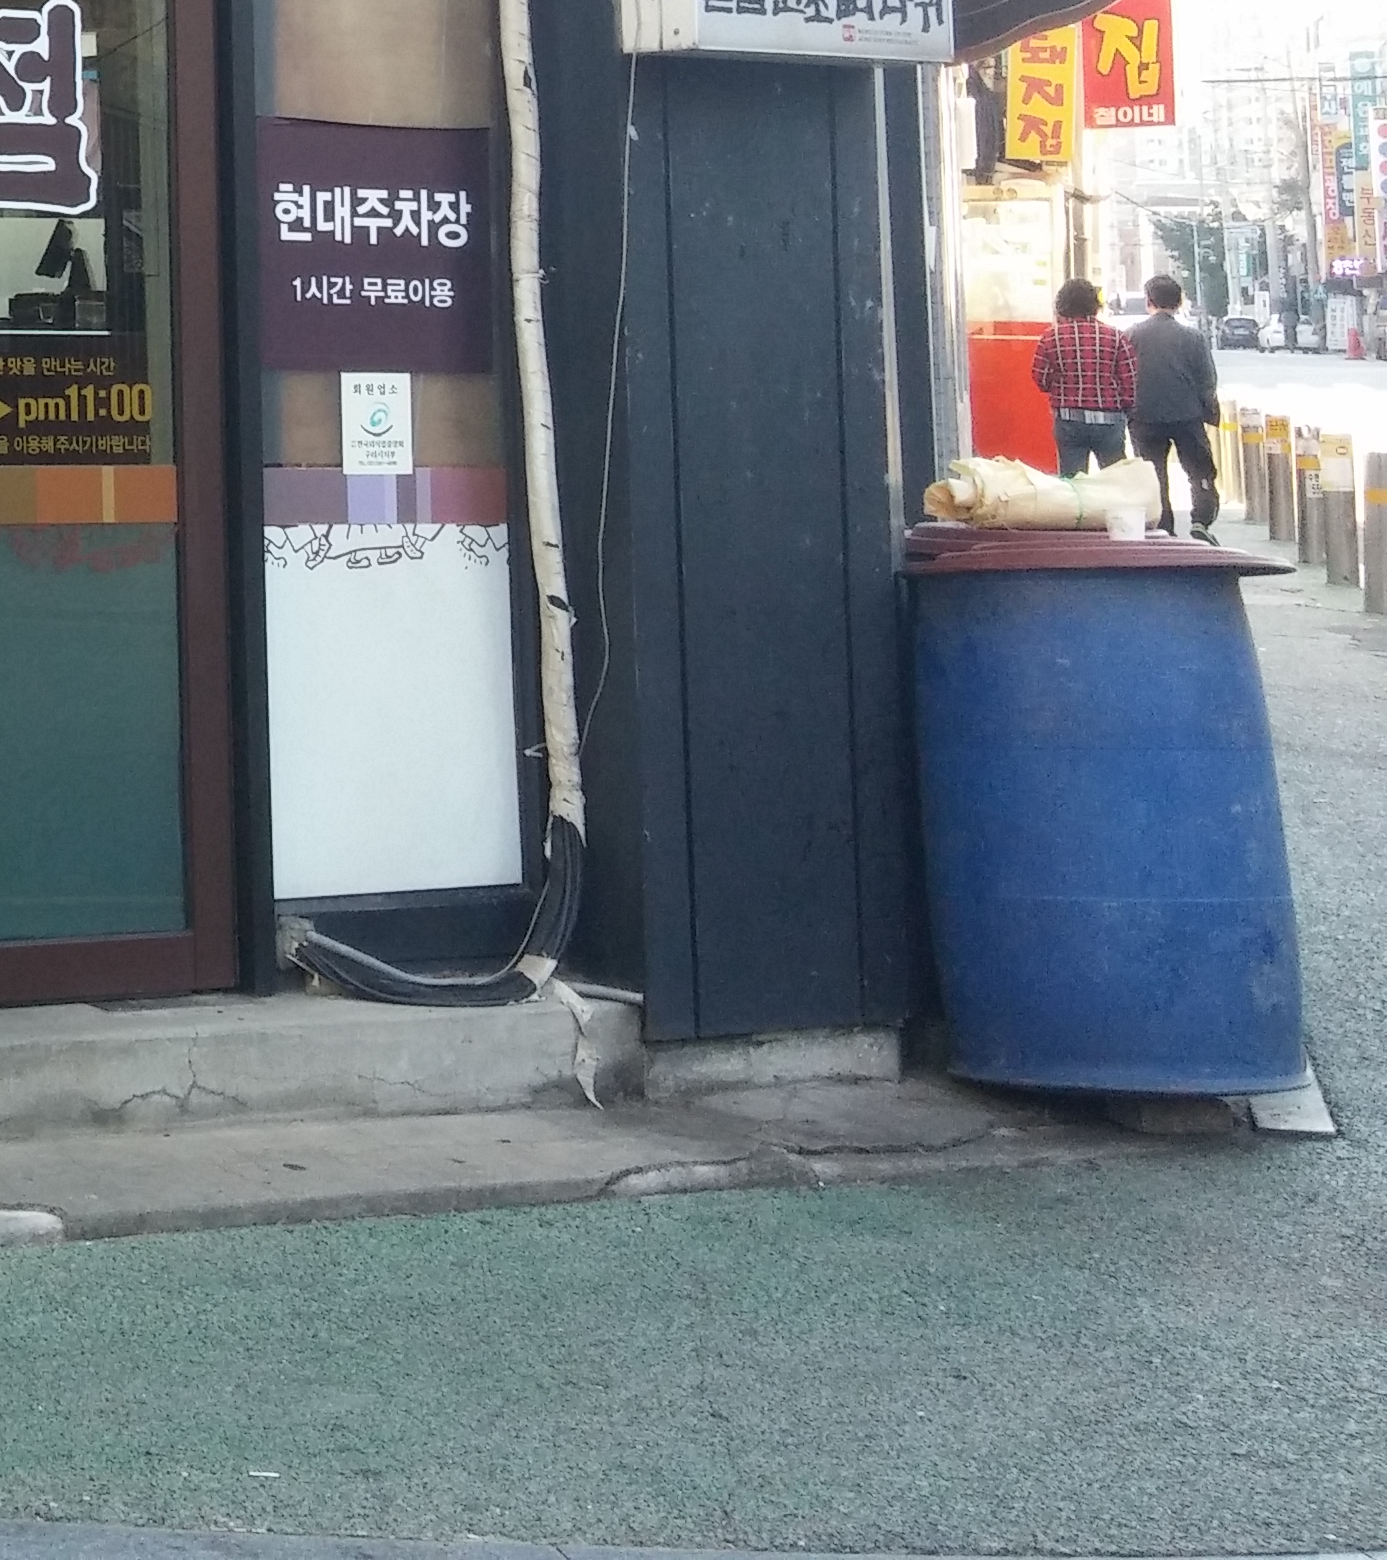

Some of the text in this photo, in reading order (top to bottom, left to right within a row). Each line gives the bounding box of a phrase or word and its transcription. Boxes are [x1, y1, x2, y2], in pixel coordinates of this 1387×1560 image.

[272, 183, 472, 248] 현대주차장
[292, 275, 455, 308] 1시간 무료이용
[7, 356, 37, 377] 맛을
[41, 356, 84, 377] 만나는
[87, 357, 116, 377] 시간
[352, 383, 398, 396] 회원업소
